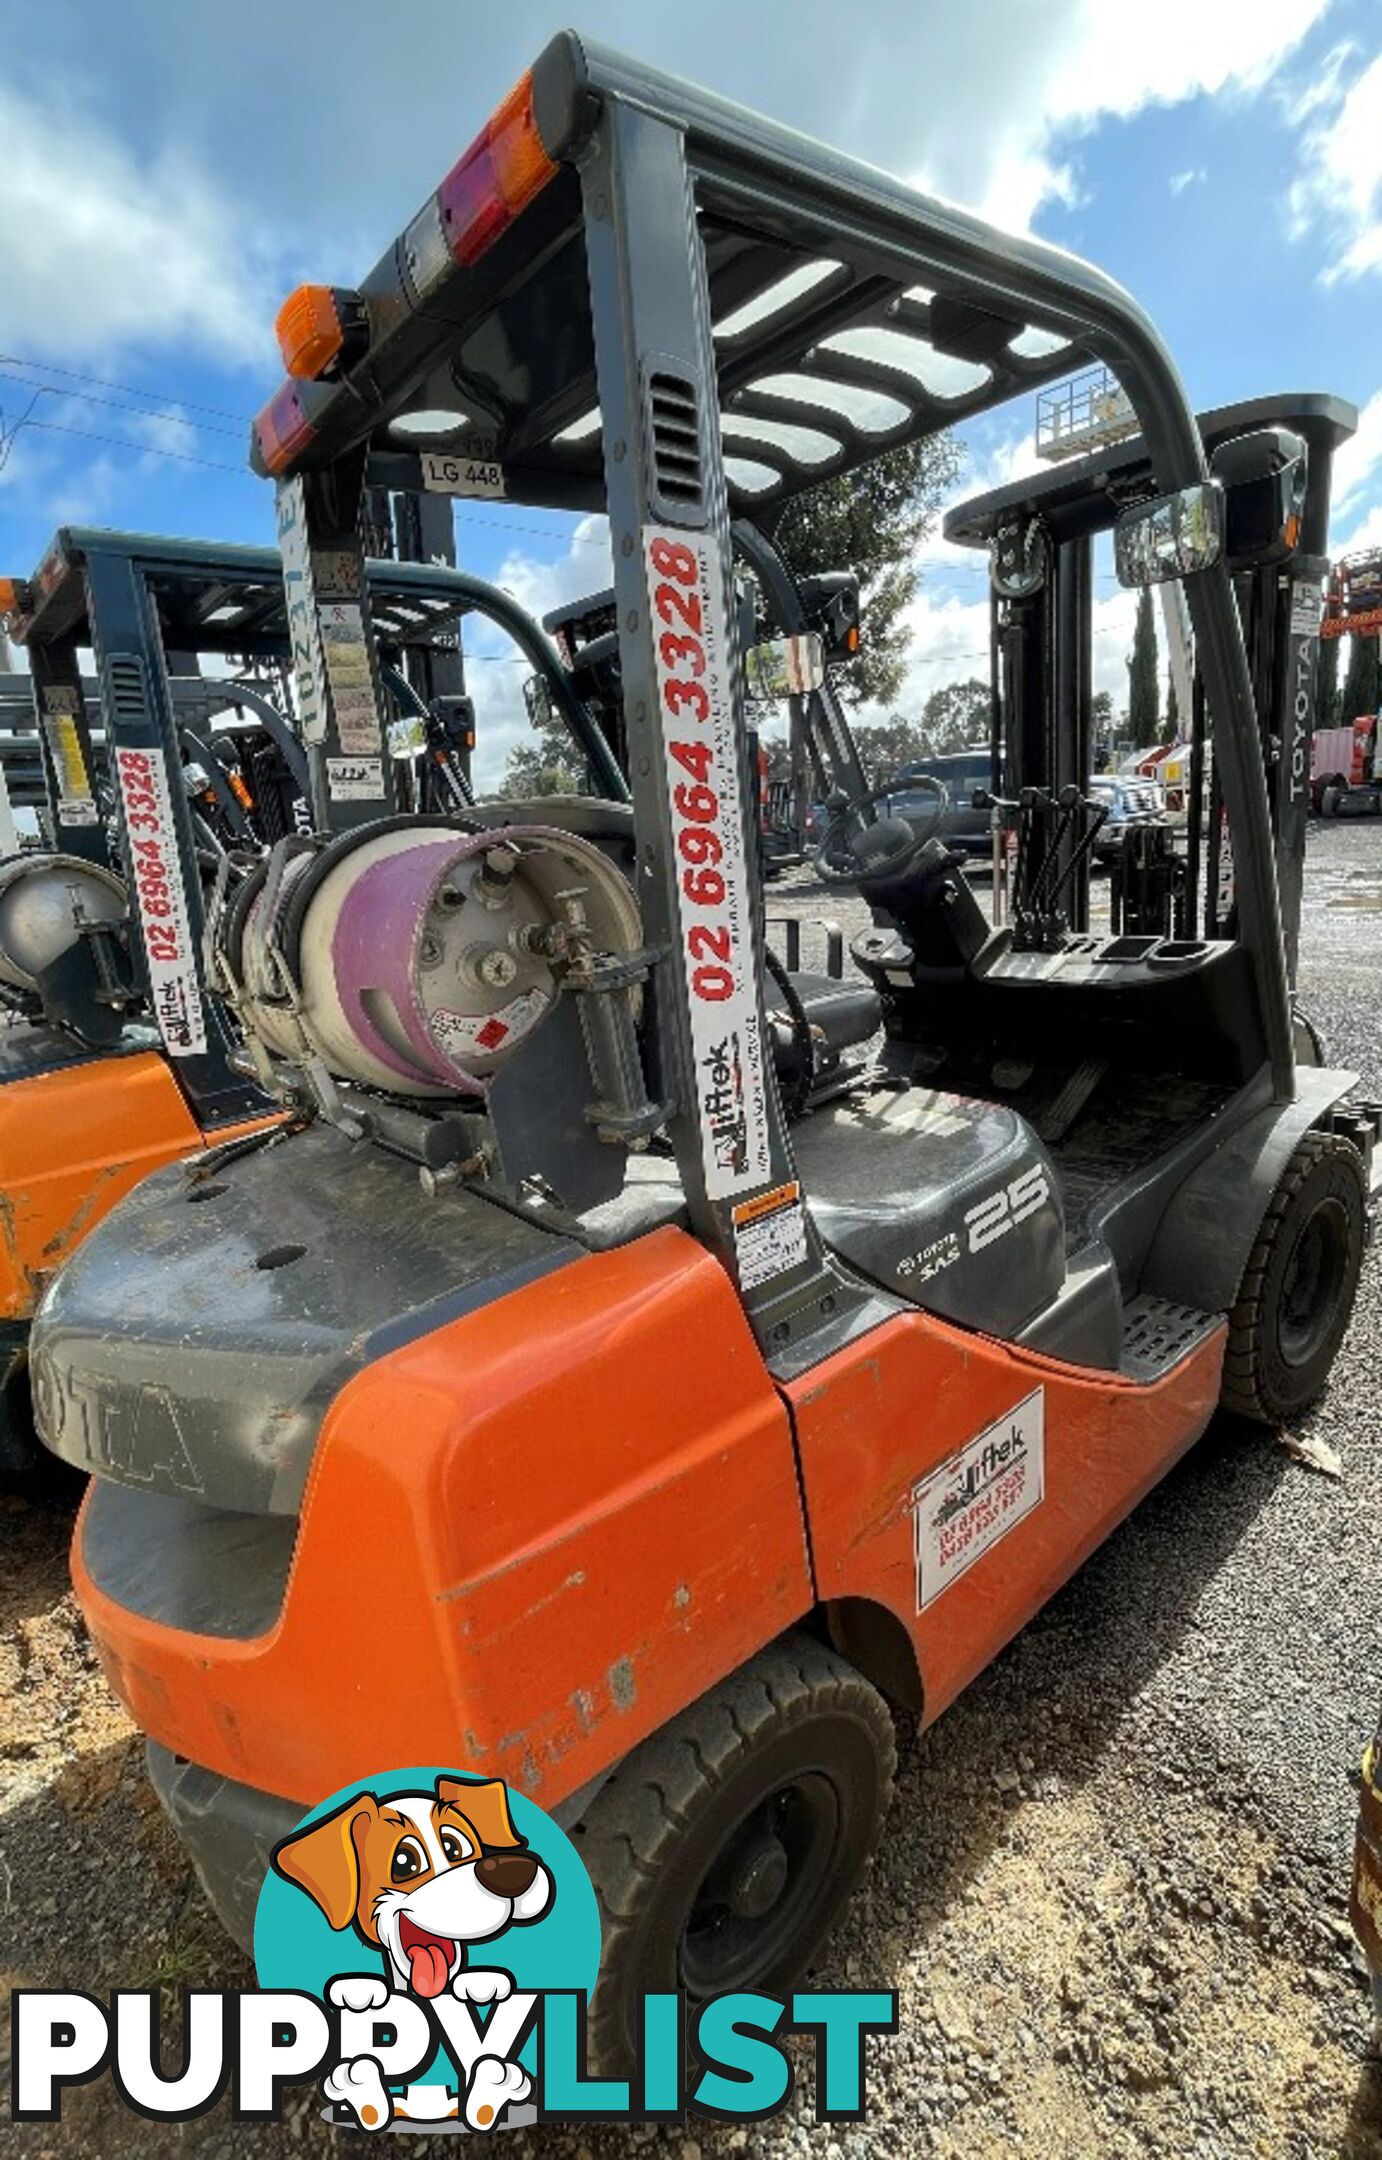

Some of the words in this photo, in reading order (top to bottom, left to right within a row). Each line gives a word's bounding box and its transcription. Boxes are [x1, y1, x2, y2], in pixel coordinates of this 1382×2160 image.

[428, 460, 459, 483] LG
[465, 465, 500, 486] 448
[650, 537, 711, 723] 3328
[1290, 638, 1312, 802] TOYOTA
[119, 752, 160, 833] 3328
[669, 741, 726, 907] 6964
[134, 839, 172, 918] 6964
[146, 923, 179, 962] 02
[688, 926, 735, 1002] 02
[963, 1162, 1049, 1254] 25
[919, 1246, 961, 1283] SAS
